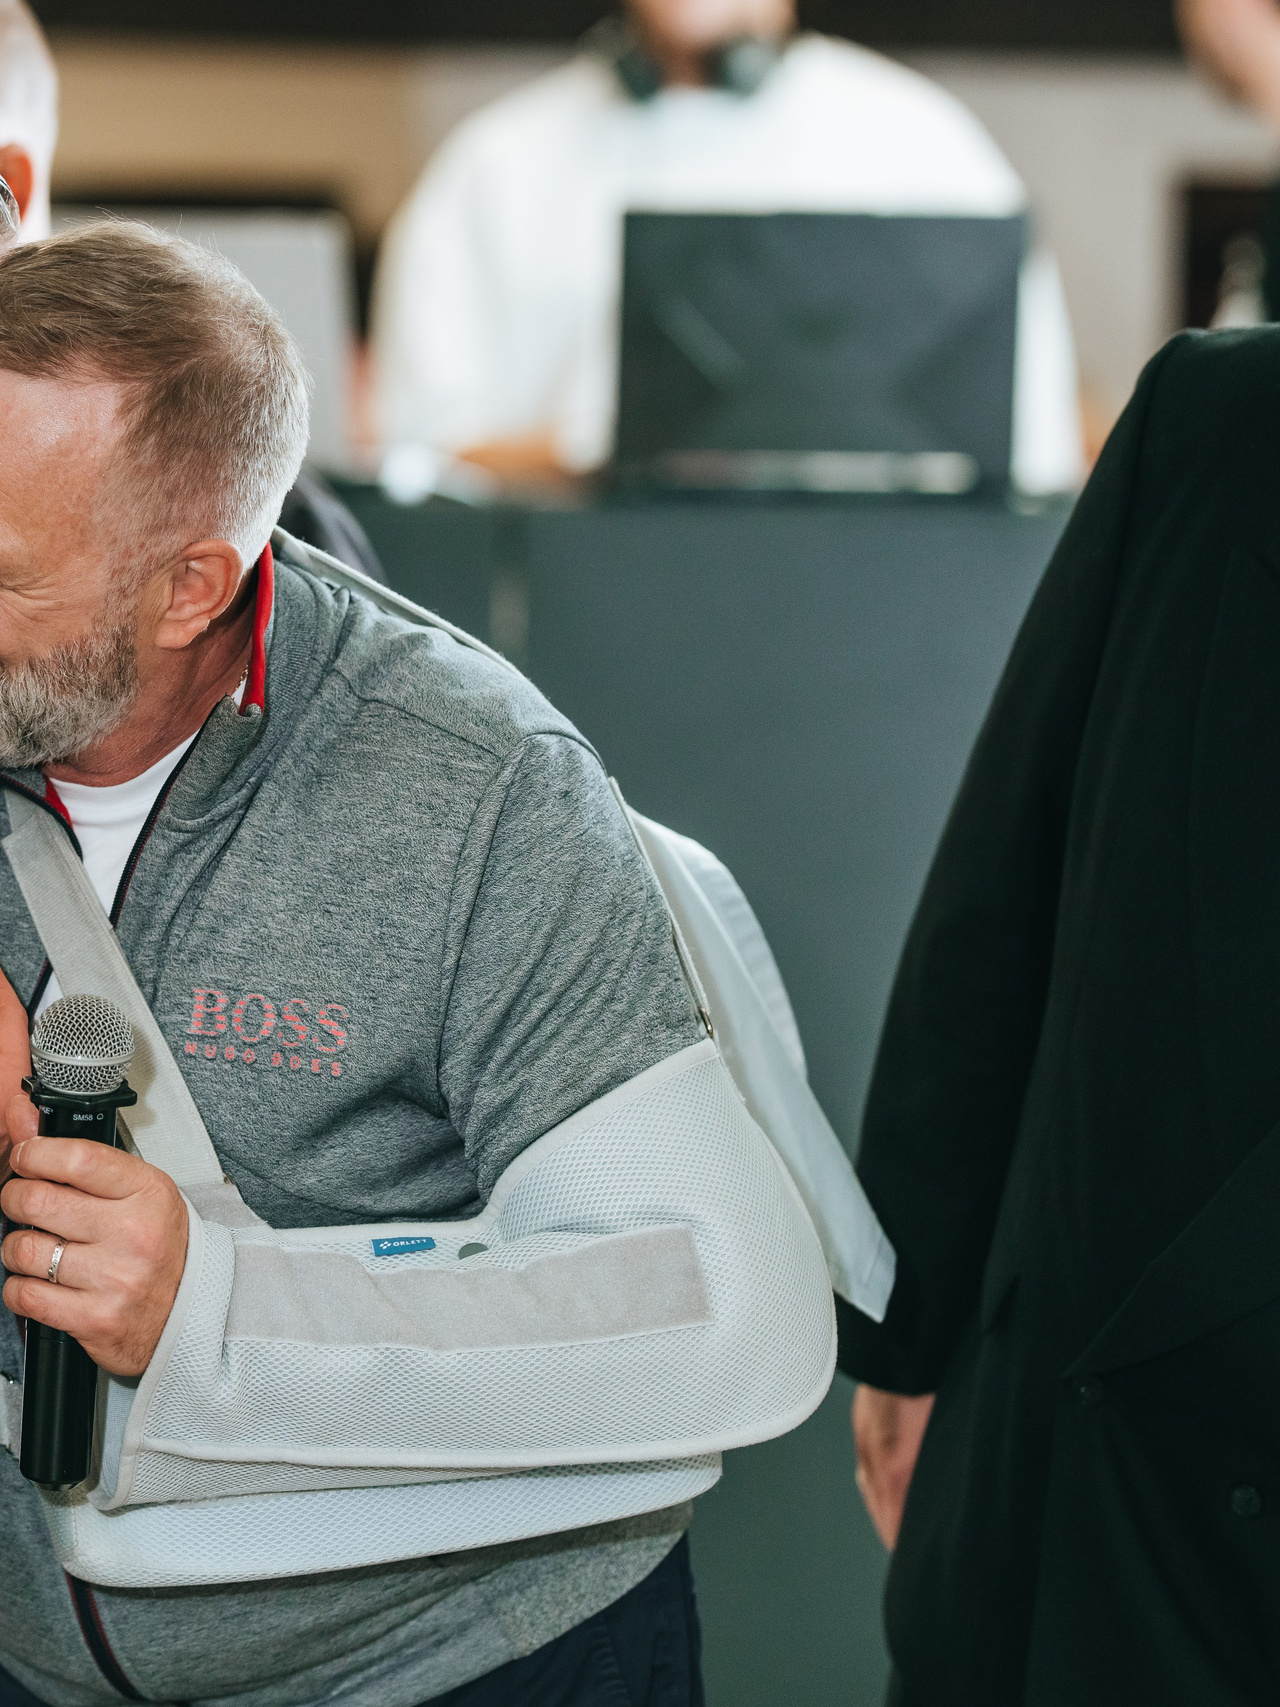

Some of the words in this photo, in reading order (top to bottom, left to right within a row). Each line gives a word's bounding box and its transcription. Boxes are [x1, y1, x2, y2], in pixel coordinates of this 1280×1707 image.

[188, 988, 347, 1052] BOSS
[185, 1042, 256, 1063] HUGO
[271, 1053, 342, 1076] BOSS
[72, 1113, 94, 1121] SM58
[392, 1239, 427, 1247] ORLETT
